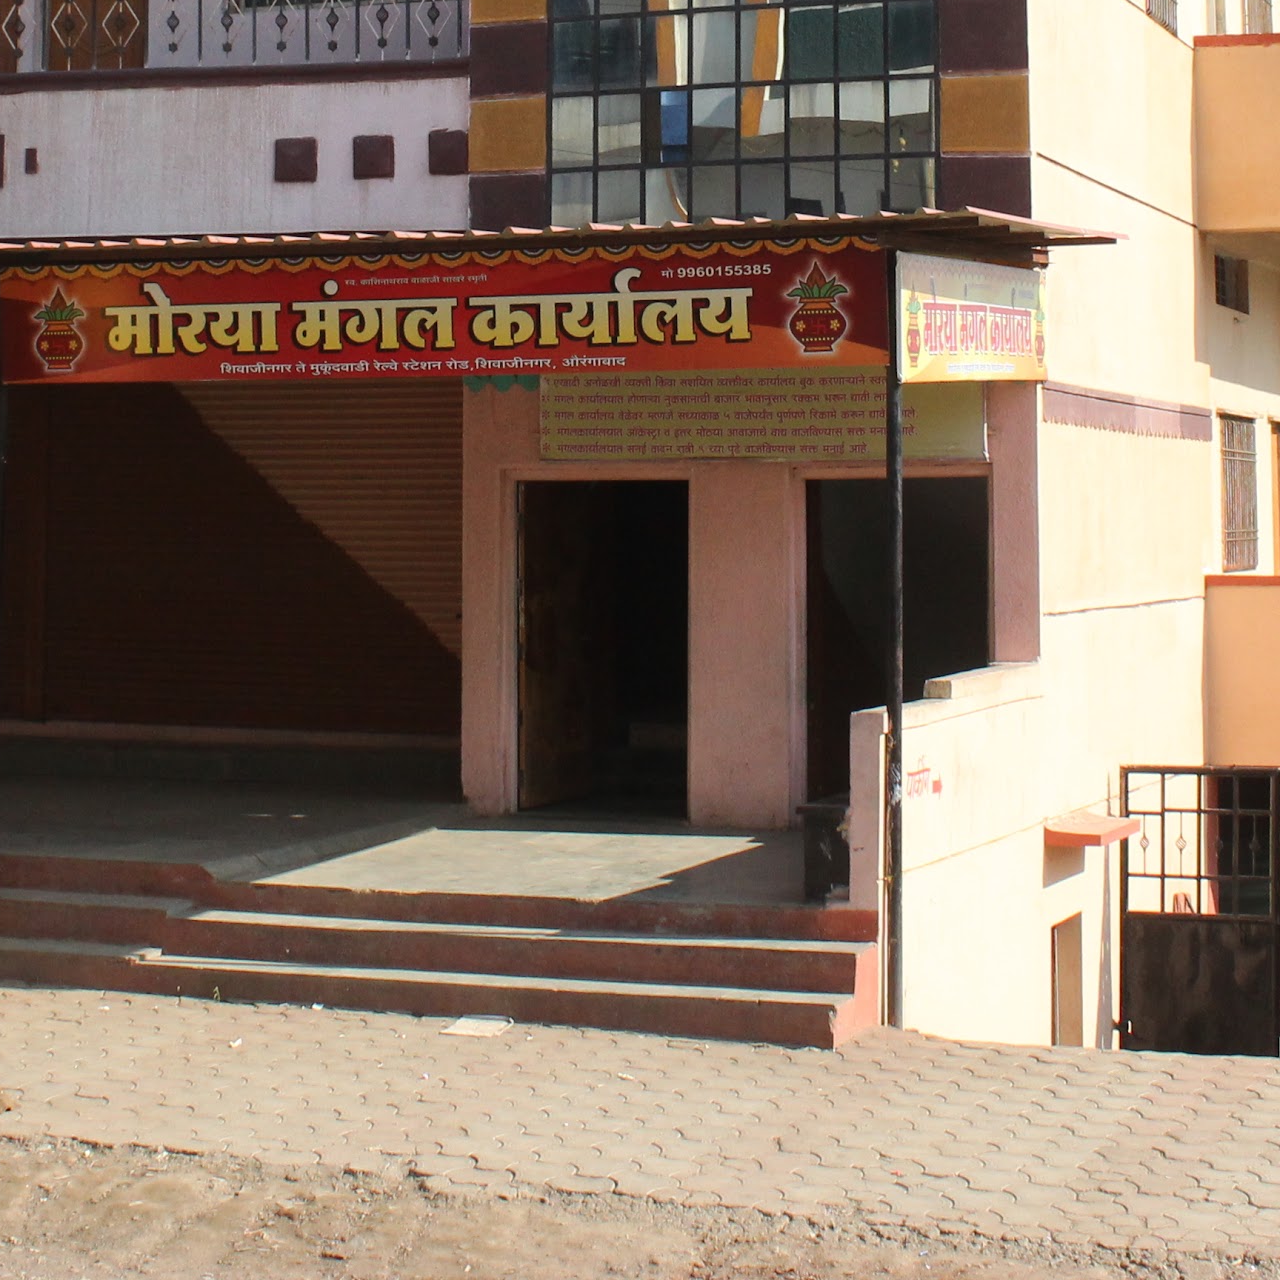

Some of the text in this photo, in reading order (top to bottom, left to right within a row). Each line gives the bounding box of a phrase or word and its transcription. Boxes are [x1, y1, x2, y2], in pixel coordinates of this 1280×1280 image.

[677, 263, 772, 278] 9960155385
[105, 267, 753, 354] मोरया मंगल कार्यालय
[220, 362, 292, 374] शिवाजीनगर
[296, 363, 306, 373] ते
[373, 359, 399, 372] रेल्वे
[402, 358, 441, 370] स्टेशन
[562, 355, 626, 368] औरंगाबाद
